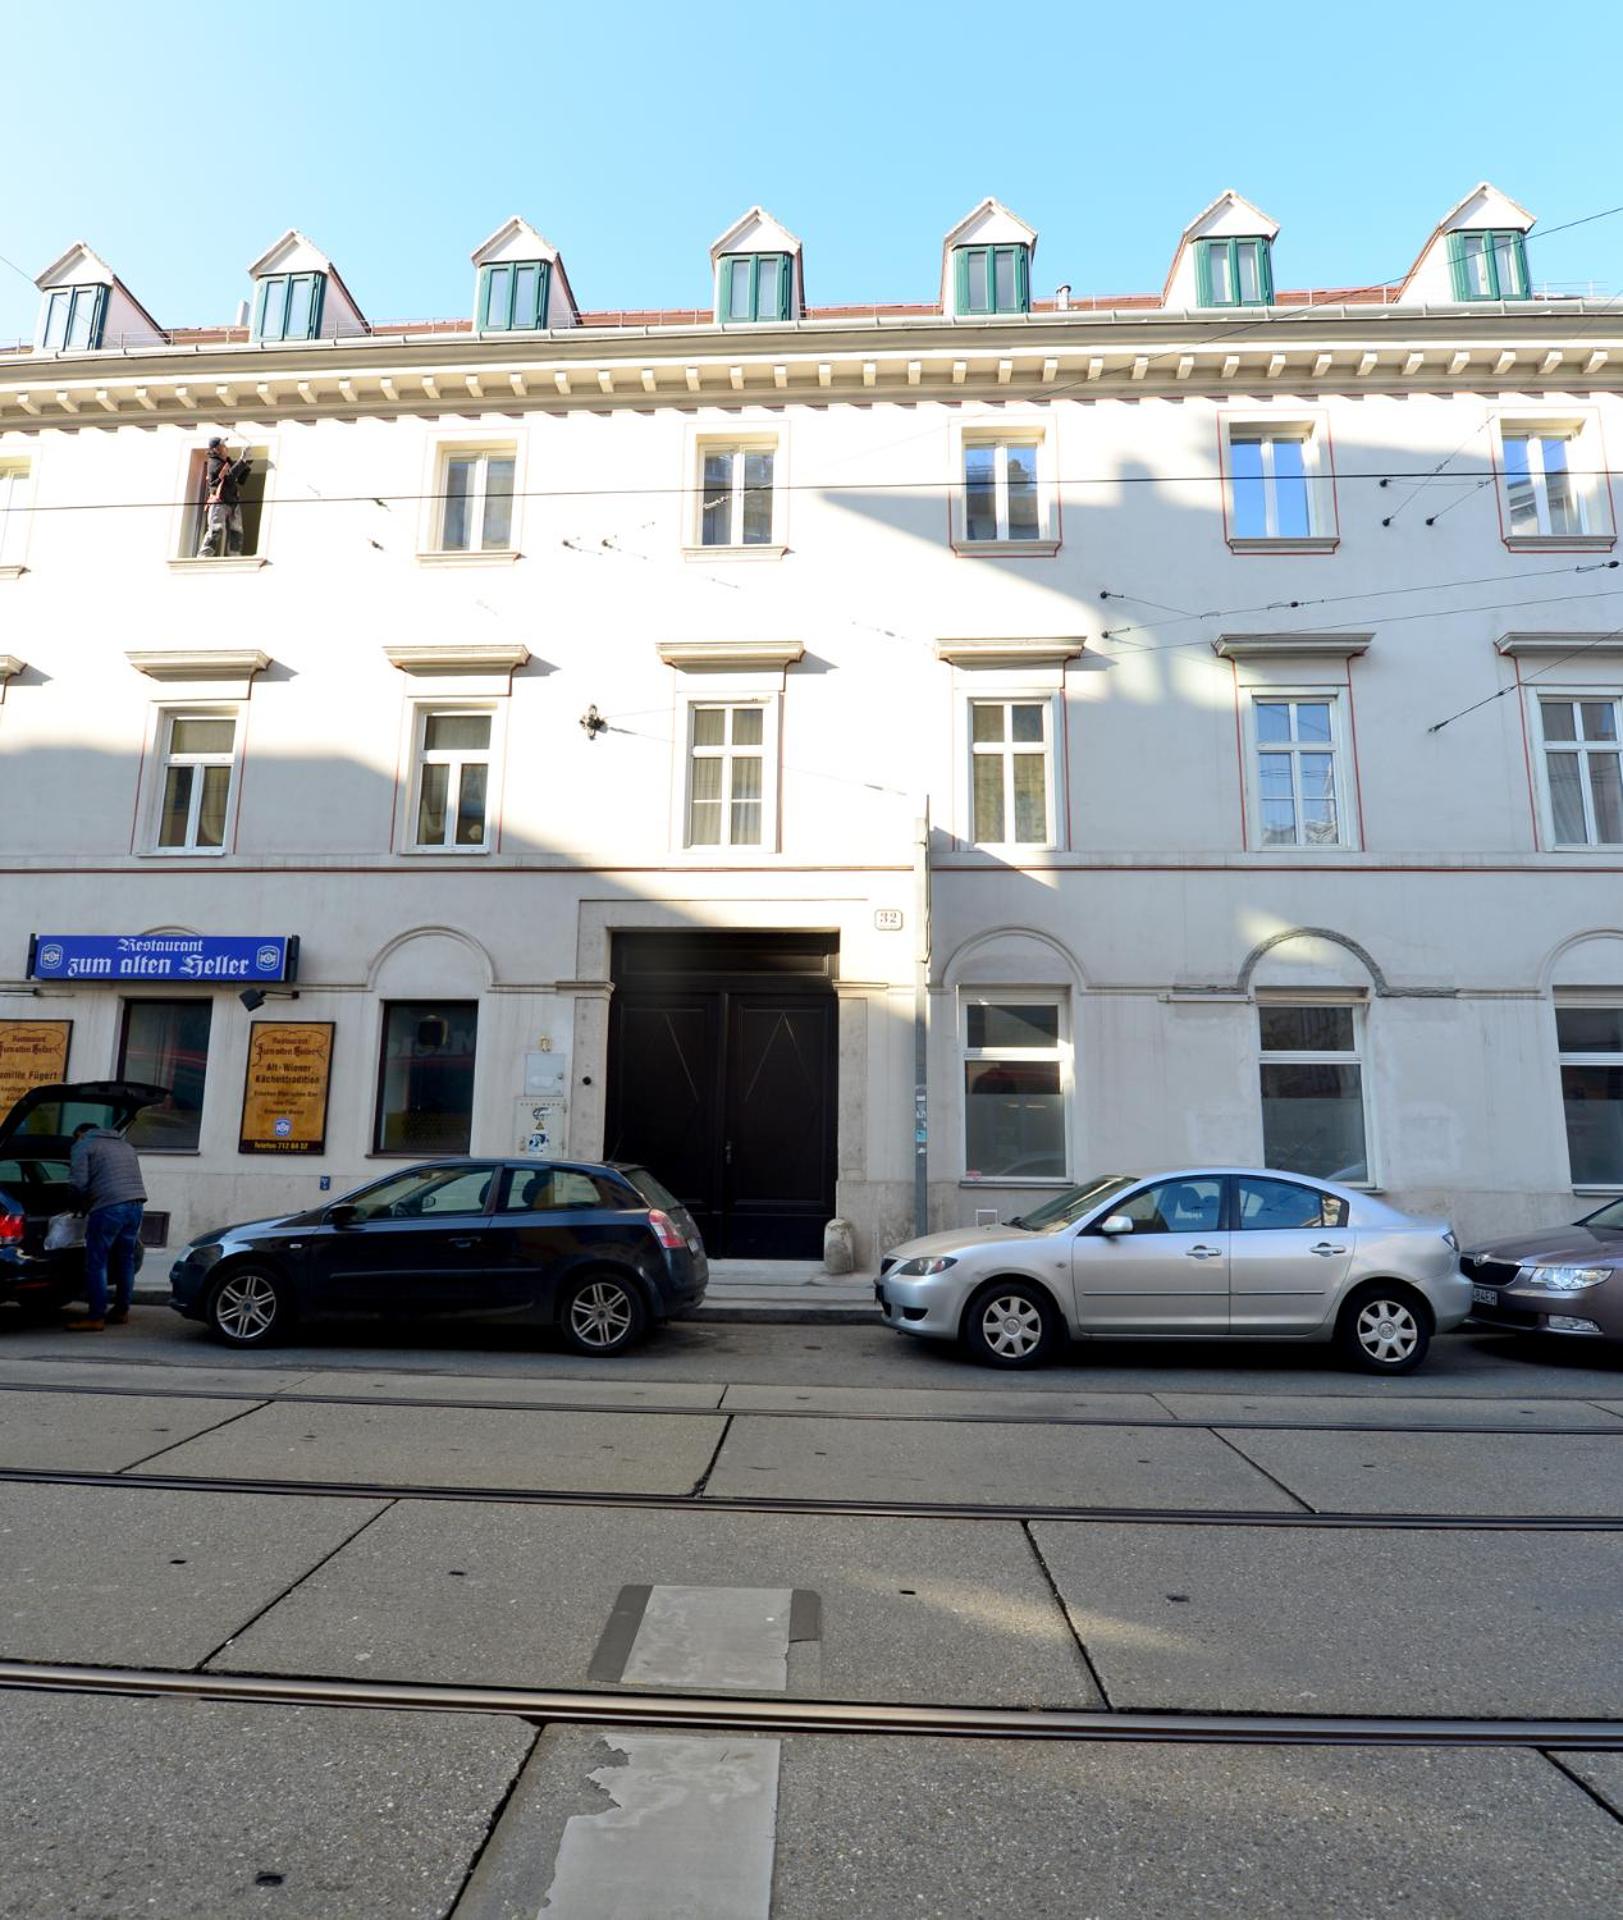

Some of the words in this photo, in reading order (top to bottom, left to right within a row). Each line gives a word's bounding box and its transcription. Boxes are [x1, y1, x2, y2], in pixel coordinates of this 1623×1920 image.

[880, 912, 897, 923] 32
[117, 938, 204, 953] Restaurant
[67, 957, 112, 976] zum
[120, 956, 172, 974] alten
[179, 954, 249, 976] Heller
